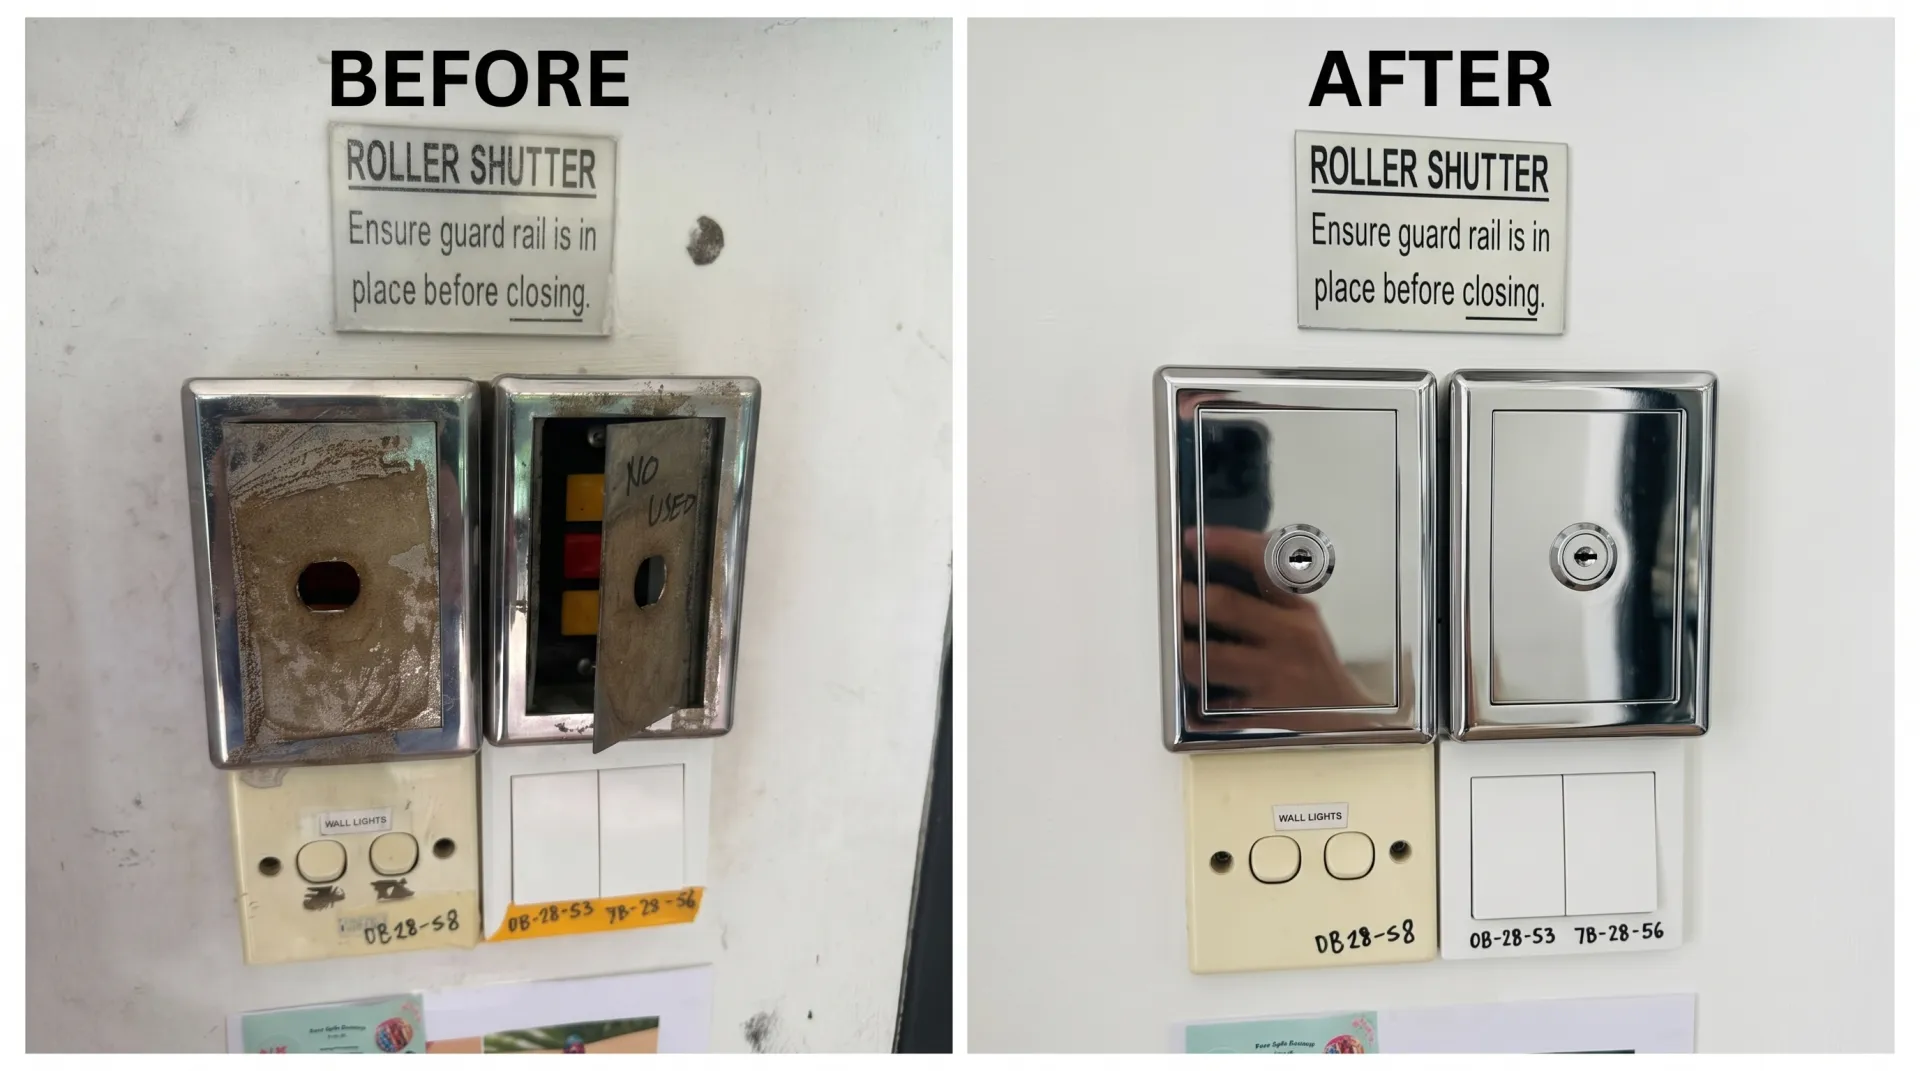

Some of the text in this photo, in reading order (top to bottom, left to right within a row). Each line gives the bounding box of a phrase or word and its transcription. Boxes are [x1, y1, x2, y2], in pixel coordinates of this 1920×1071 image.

[347, 138, 597, 190] ROLLER SHUTTER
[1310, 145, 1549, 193] ROLLER SHUTTER
[349, 209, 597, 257] Ensure guard rail is in
[1312, 211, 1550, 257] Ensure guard rail is in
[352, 270, 591, 317] place before closing.
[1315, 269, 1545, 316] place before closing.
[626, 455, 660, 497] NO
[648, 492, 697, 527] USED
[325, 816, 387, 828] WALL LIGHTS
[1278, 811, 1343, 823] WALL LIGHTS
